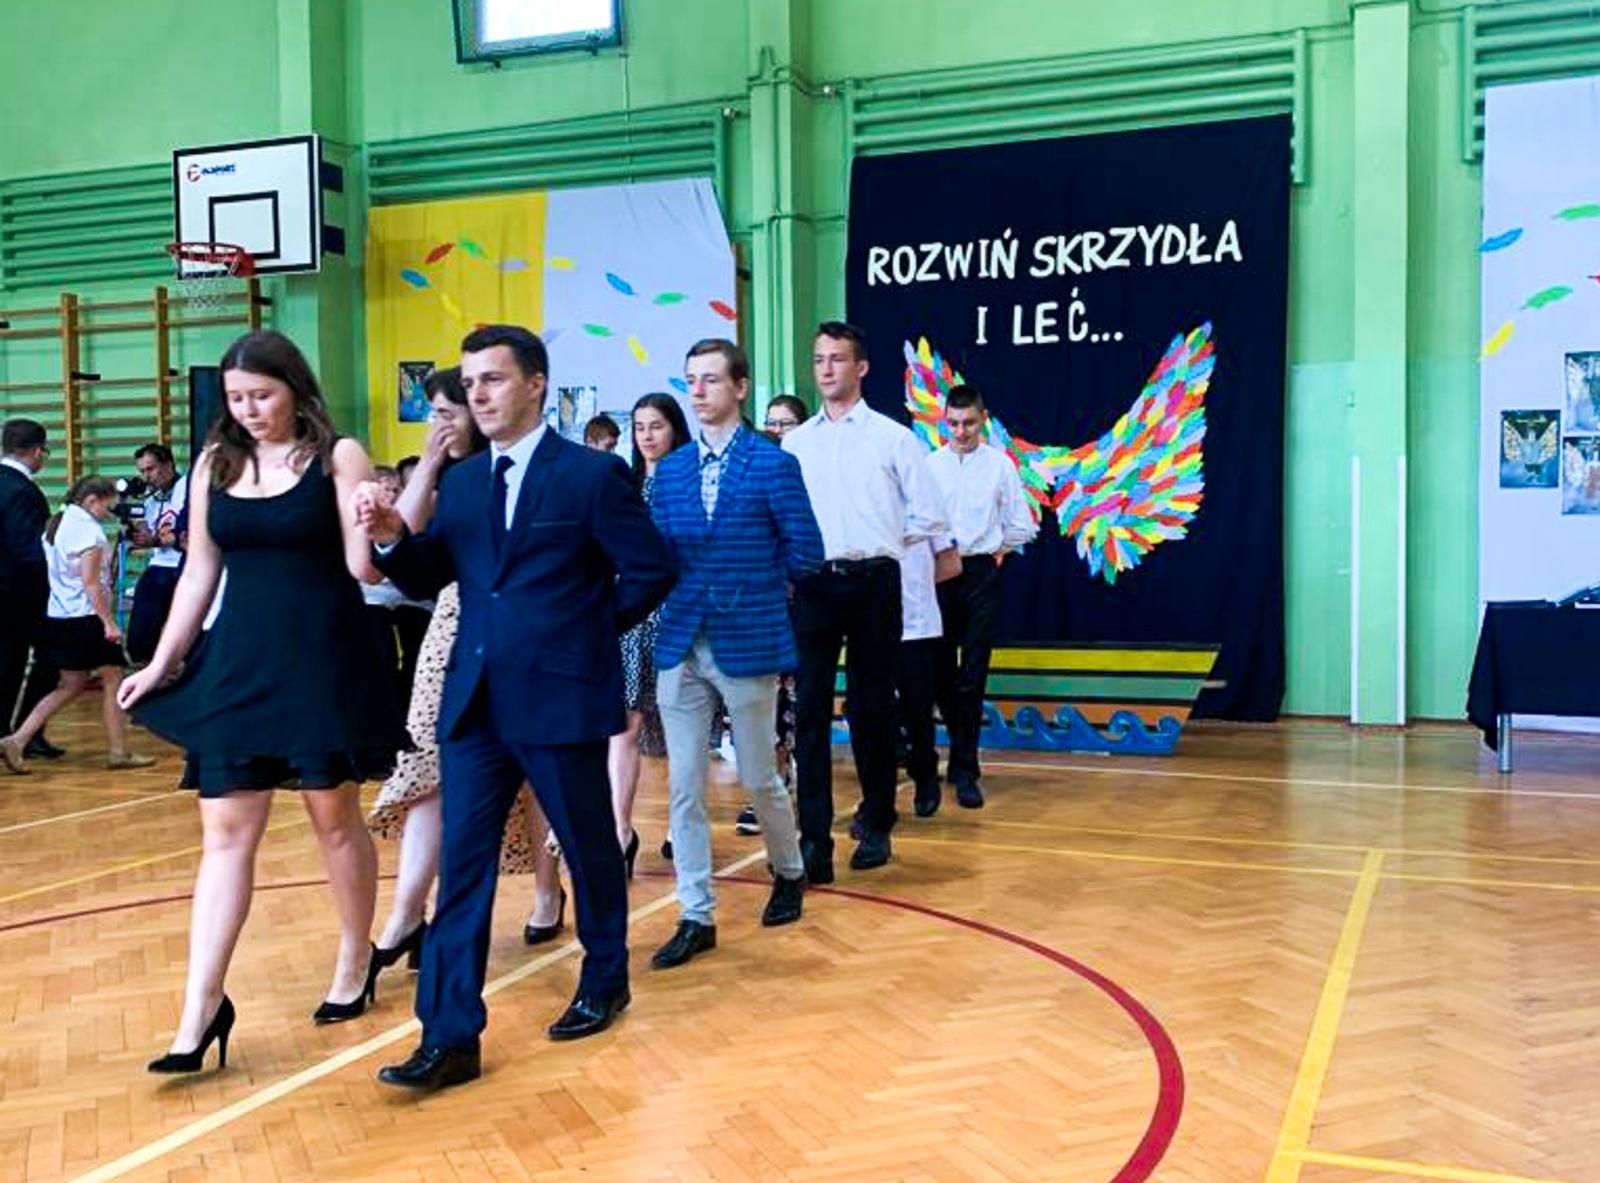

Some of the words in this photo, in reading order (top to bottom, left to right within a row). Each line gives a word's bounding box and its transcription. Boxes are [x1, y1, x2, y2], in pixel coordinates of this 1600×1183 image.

[868, 228, 1018, 285] ROZWIŃ
[1030, 220, 1242, 277] SKRZYDŁA
[976, 307, 987, 344] I
